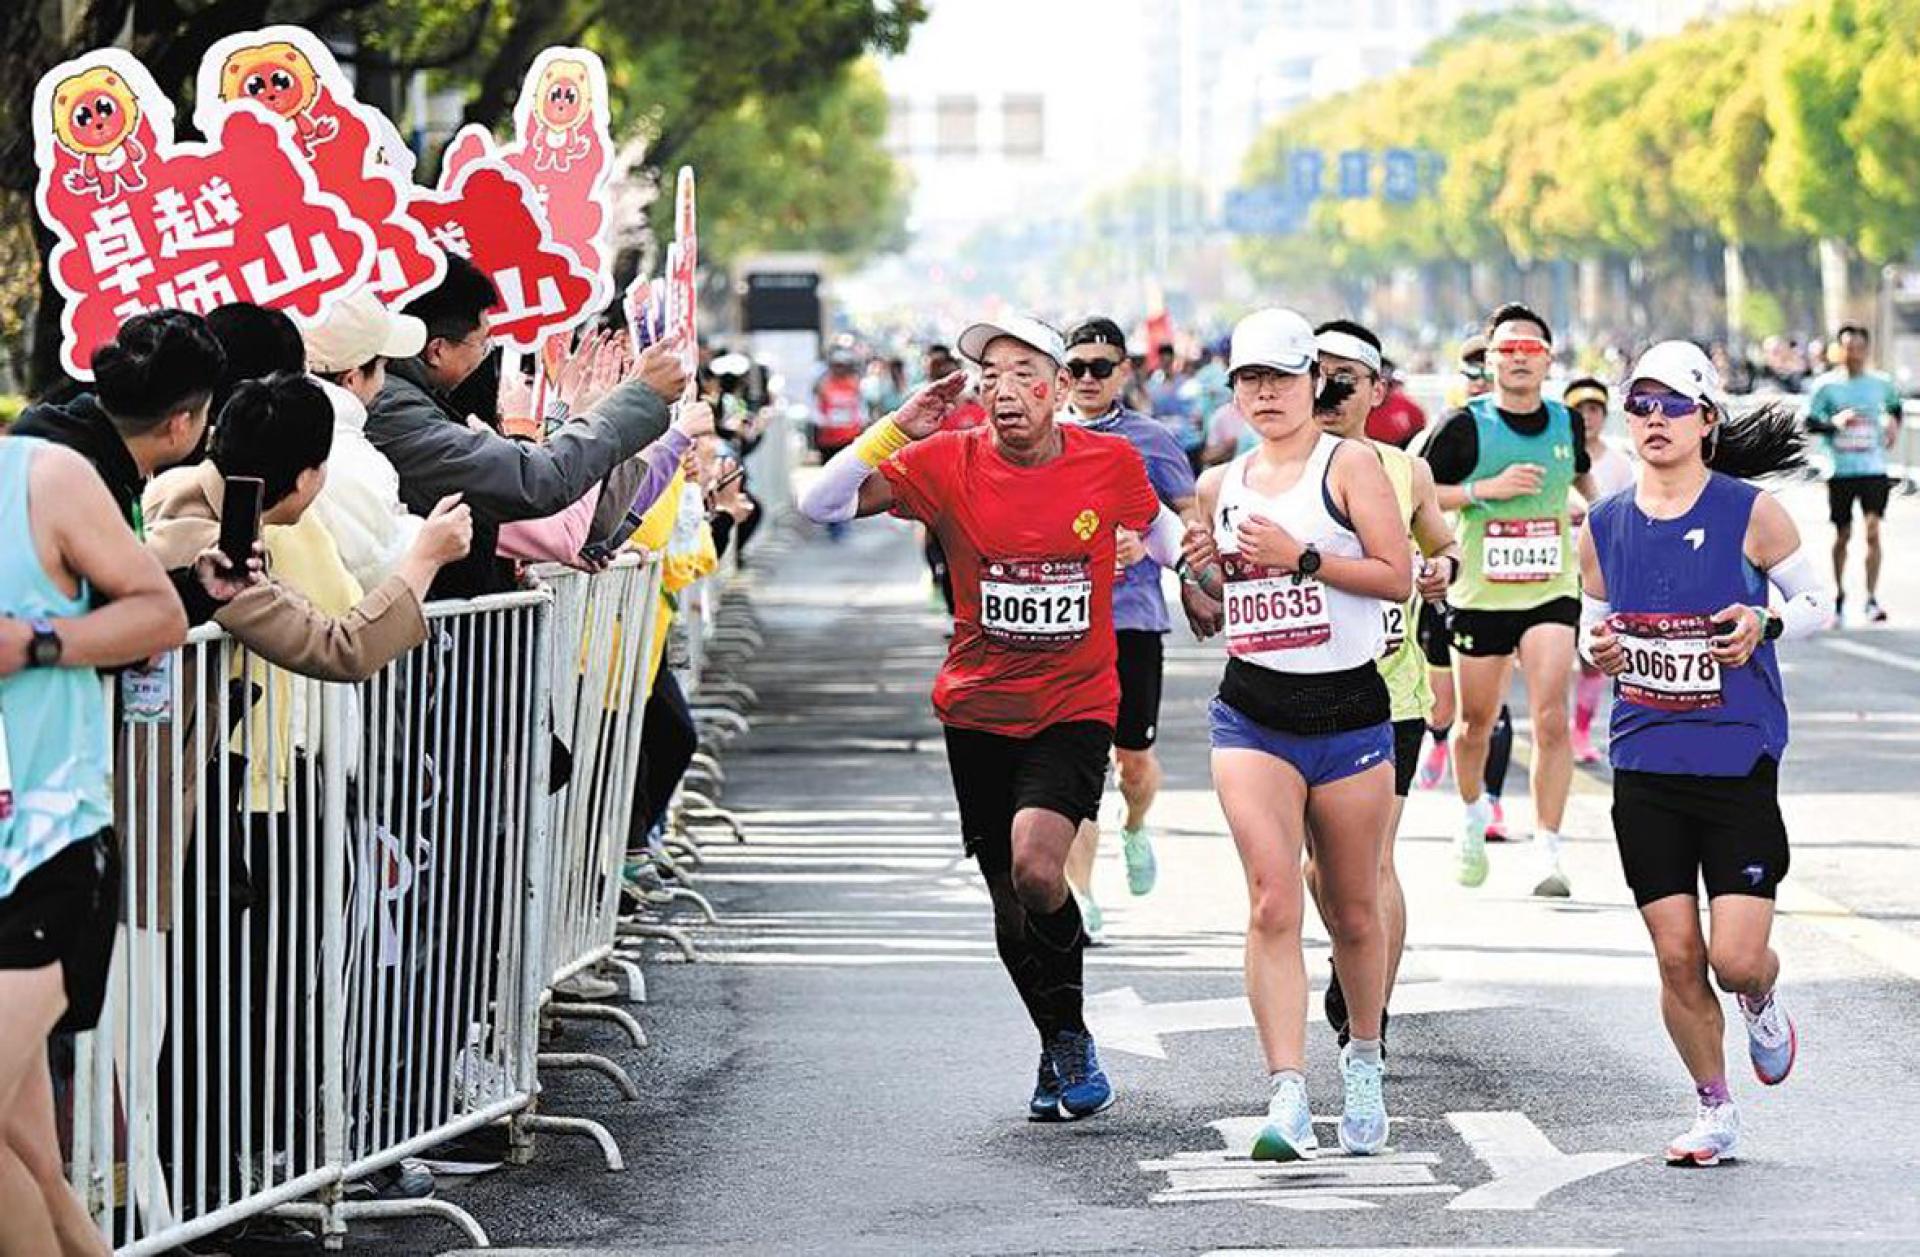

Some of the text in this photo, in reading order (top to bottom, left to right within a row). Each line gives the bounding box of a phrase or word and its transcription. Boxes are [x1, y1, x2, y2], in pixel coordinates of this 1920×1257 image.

[85, 176, 242, 294] 卓越
[1488, 547, 1558, 567] C10442
[986, 595, 1086, 624] B06121
[1228, 586, 1322, 625] B06635
